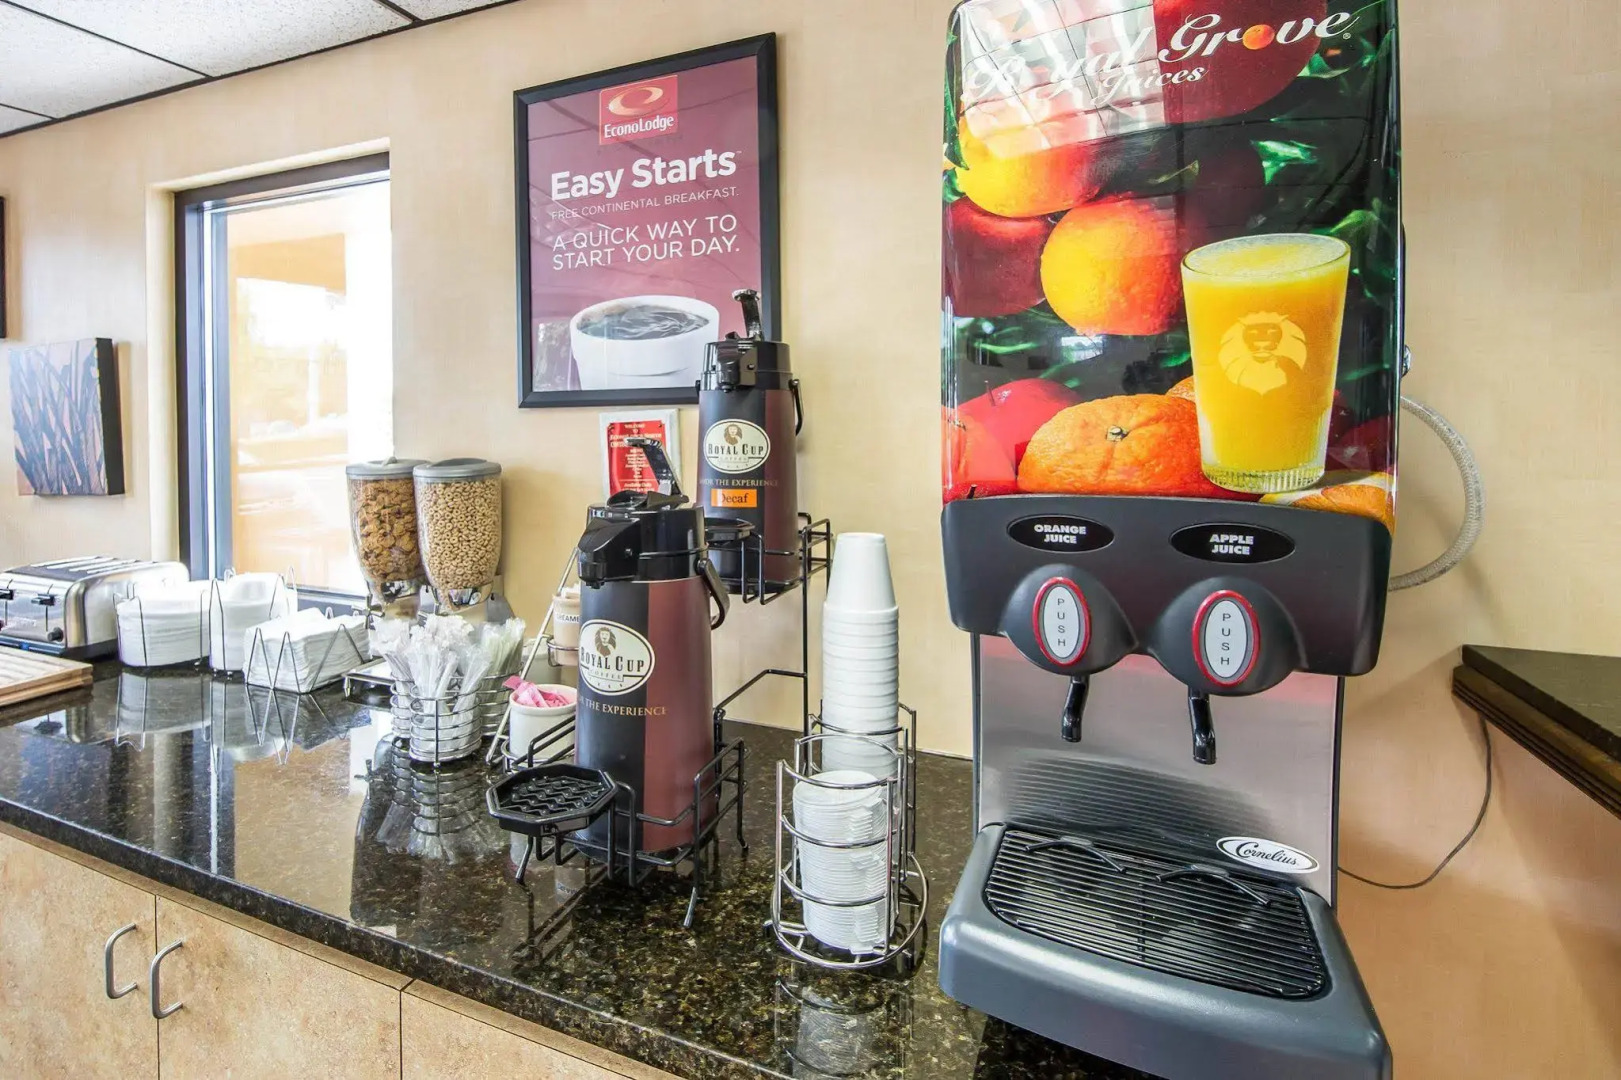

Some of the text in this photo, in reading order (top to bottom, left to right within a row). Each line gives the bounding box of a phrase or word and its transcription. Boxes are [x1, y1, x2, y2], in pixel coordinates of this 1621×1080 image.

[970, 26, 1153, 99] Ryal
[603, 114, 675, 139] EconoLodge
[551, 149, 737, 201] Easy Starts
[551, 186, 740, 220] FREE CONTINENTAL BREAKFAST.
[552, 213, 738, 252] A QUICK WAY TO
[552, 234, 741, 271] START YOUR DAY.
[707, 443, 764, 456] ROYAL CUP
[715, 479, 730, 487] THE
[731, 479, 778, 488] EXPERIENCE
[1034, 524, 1087, 535] ORANGE
[1043, 533, 1077, 544] JUICE
[1209, 533, 1254, 545] APPLE
[1211, 544, 1250, 556] JUICE
[1056, 598, 1066, 648] PUSH
[1219, 612, 1232, 666] PUSH
[580, 646, 645, 673] ROYAL CUP
[585, 699, 600, 711] THE
[602, 703, 667, 717] EXPERIENCE
[1235, 841, 1298, 866] Cornelius
